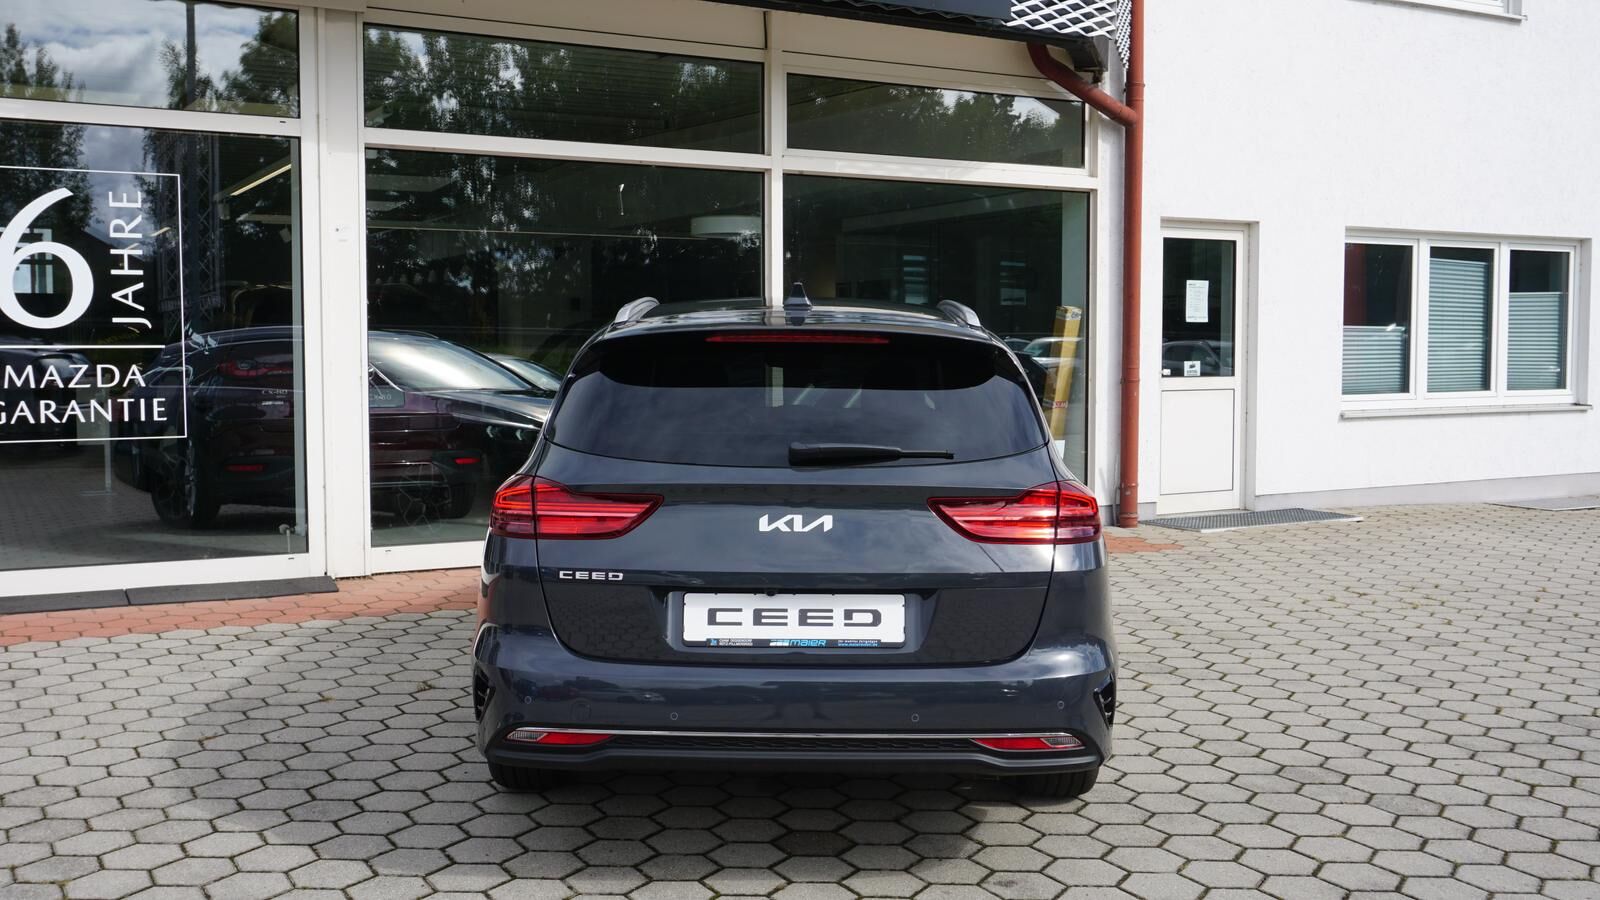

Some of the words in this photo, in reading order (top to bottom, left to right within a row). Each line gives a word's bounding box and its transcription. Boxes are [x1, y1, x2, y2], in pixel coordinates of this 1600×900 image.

[0, 187, 94, 329] 6
[108, 190, 152, 329] JAHRE
[4, 363, 146, 389] MAZDA
[759, 514, 833, 532] KIA
[559, 570, 624, 581] CEED
[707, 608, 882, 627] CEED
